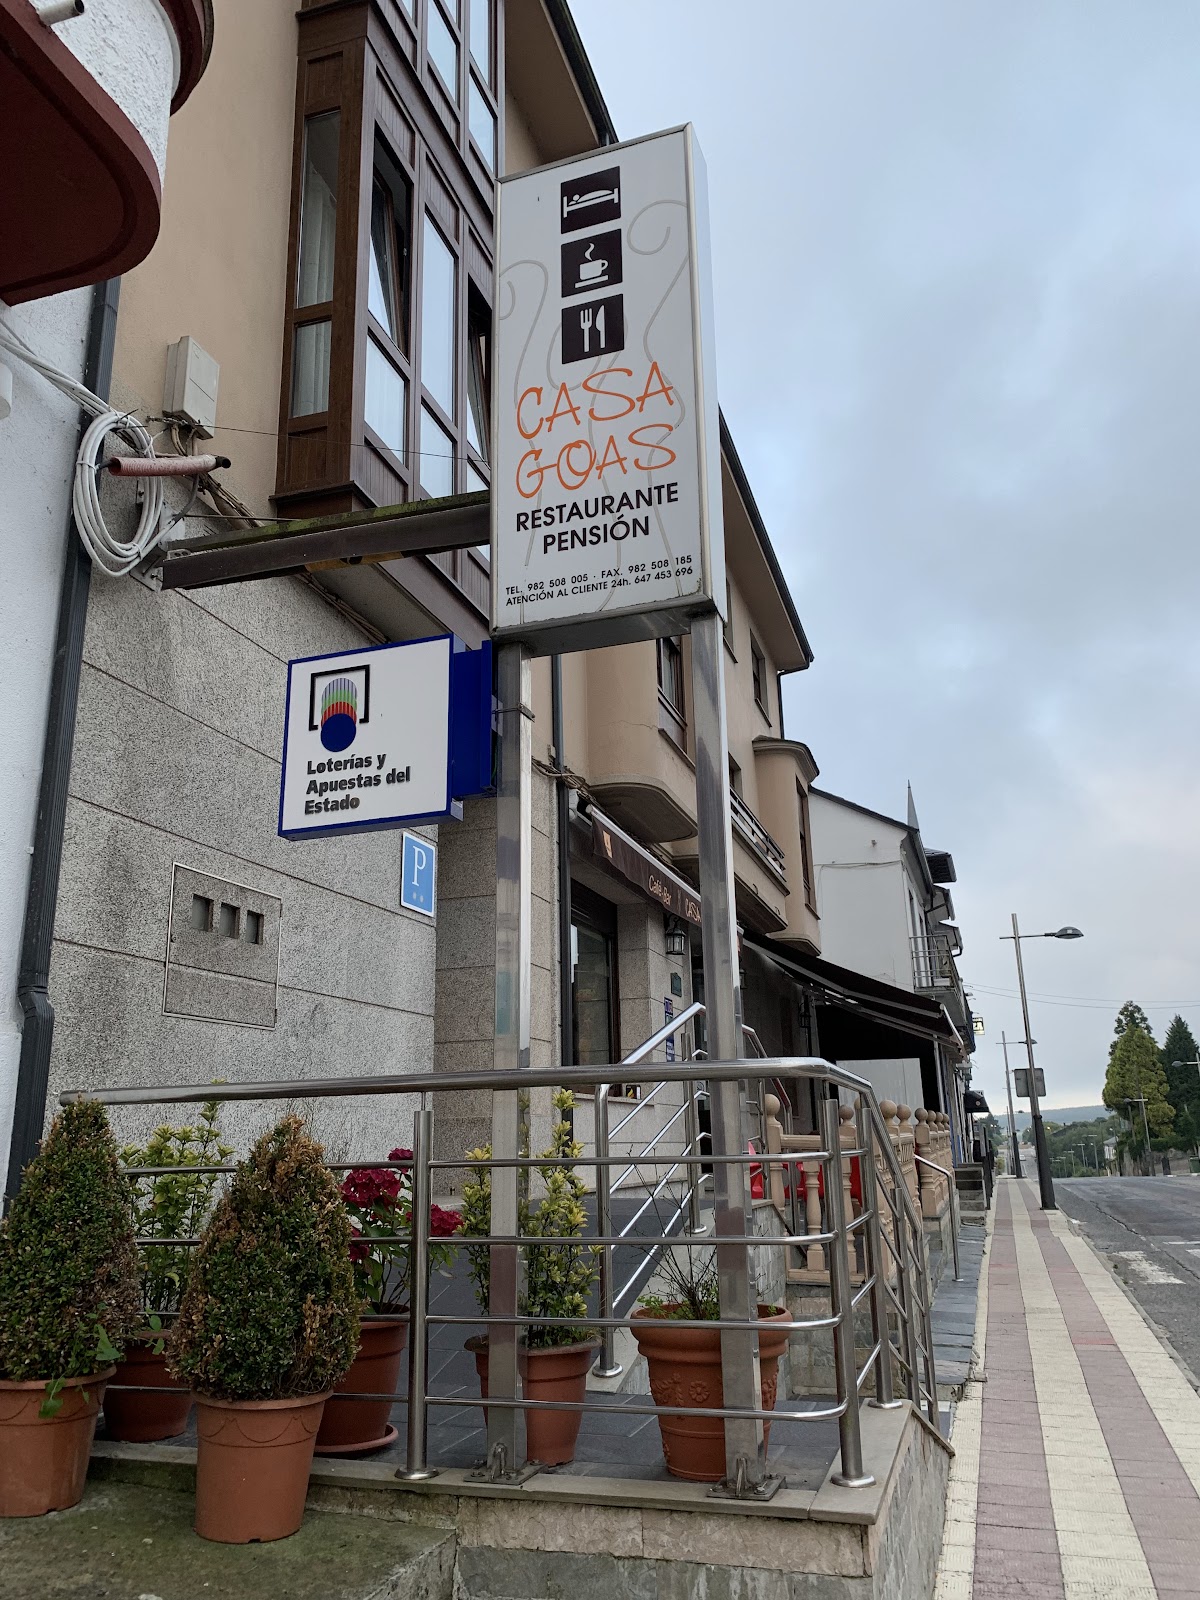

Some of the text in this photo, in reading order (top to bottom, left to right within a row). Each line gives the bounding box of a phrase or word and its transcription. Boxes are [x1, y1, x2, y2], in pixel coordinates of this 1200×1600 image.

[517, 361, 674, 440] CASA
[516, 423, 676, 498] GOAS
[516, 482, 679, 532] RESTAURANTE
[543, 514, 650, 555] PENSIÓN
[505, 554, 692, 596] TEL. 982 508 005 FAX. 982 508 185
[505, 566, 693, 607] ATENCIÓN AL CLIENTE 24h. 647 453 696
[305, 765, 411, 797] Apuestas del
[307, 753, 387, 775] Loterías y
[304, 794, 360, 815] Estado
[411, 845, 427, 887] P
